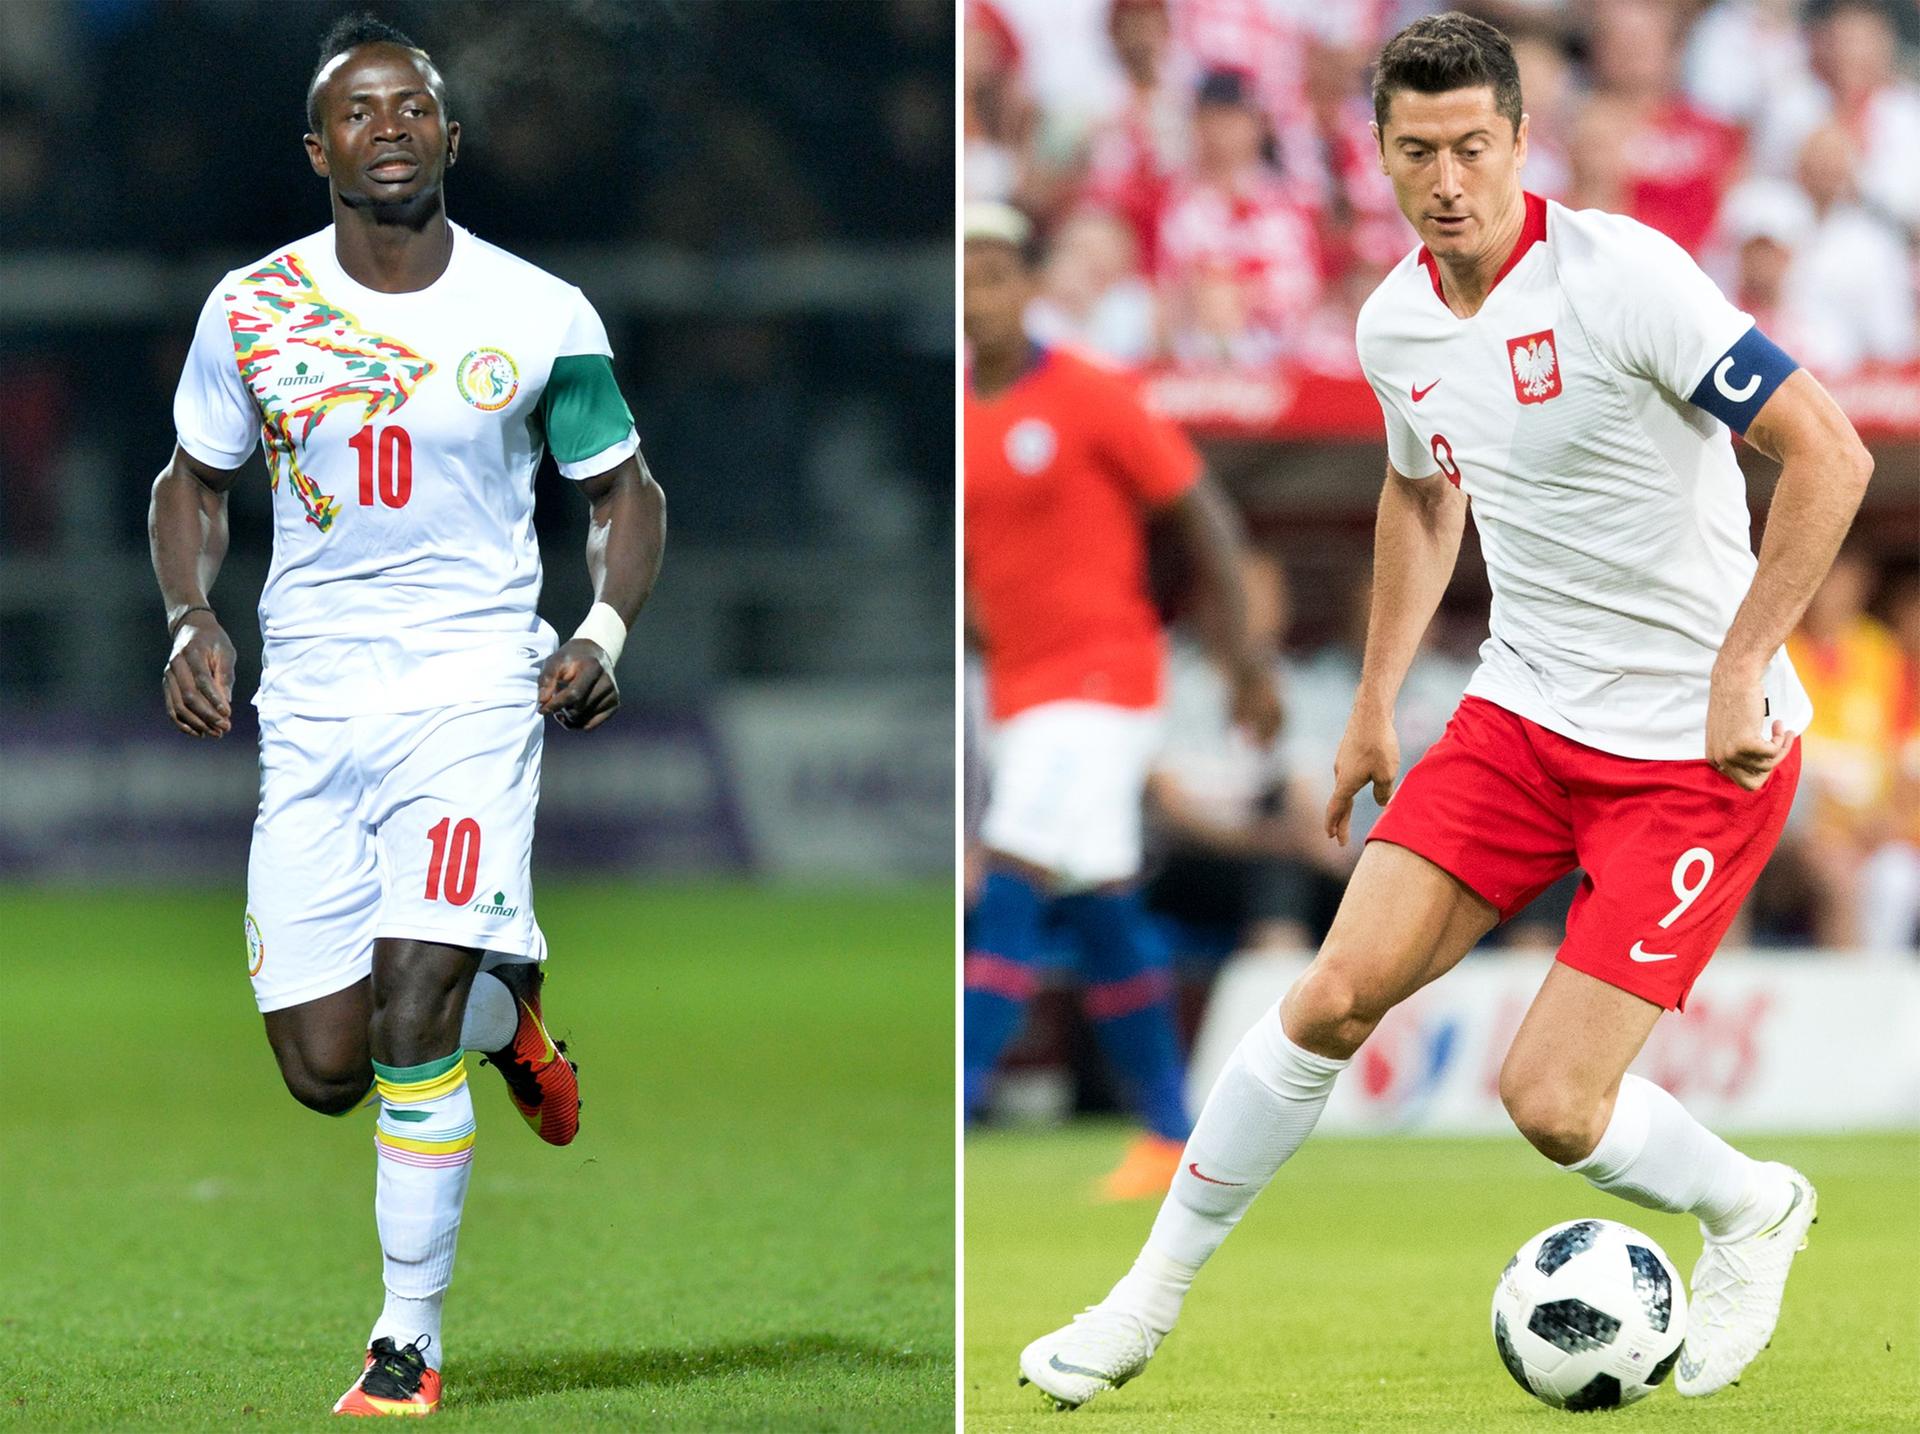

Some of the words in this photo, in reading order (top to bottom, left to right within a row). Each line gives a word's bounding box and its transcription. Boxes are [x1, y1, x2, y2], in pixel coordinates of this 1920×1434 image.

[277, 371, 325, 386] romai
[1713, 356, 1762, 402] C
[348, 424, 412, 509] 10
[423, 817, 481, 906] 10
[1658, 847, 1715, 929] 9
[473, 903, 519, 918] romai
